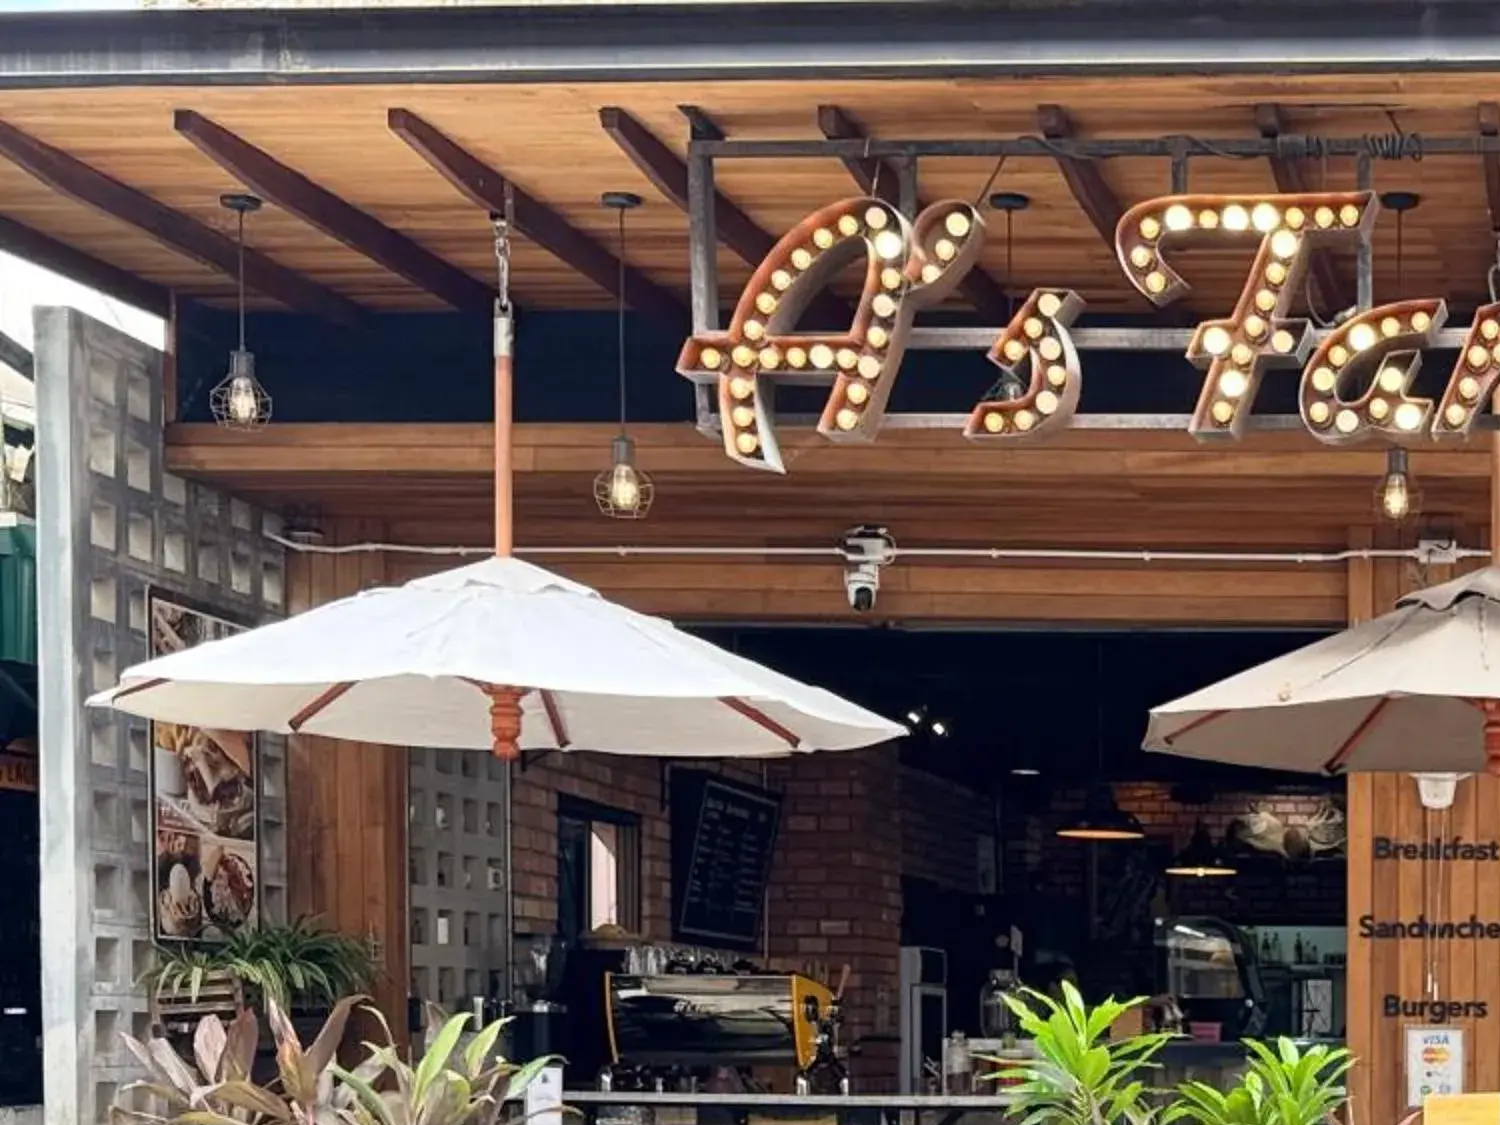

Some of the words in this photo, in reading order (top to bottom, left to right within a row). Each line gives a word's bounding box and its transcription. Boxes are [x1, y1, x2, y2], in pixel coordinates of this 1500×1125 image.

[1373, 836, 1500, 861] Breakfast
[1383, 995, 1488, 1023] Burgers
[1422, 1035, 1450, 1045] VISA
